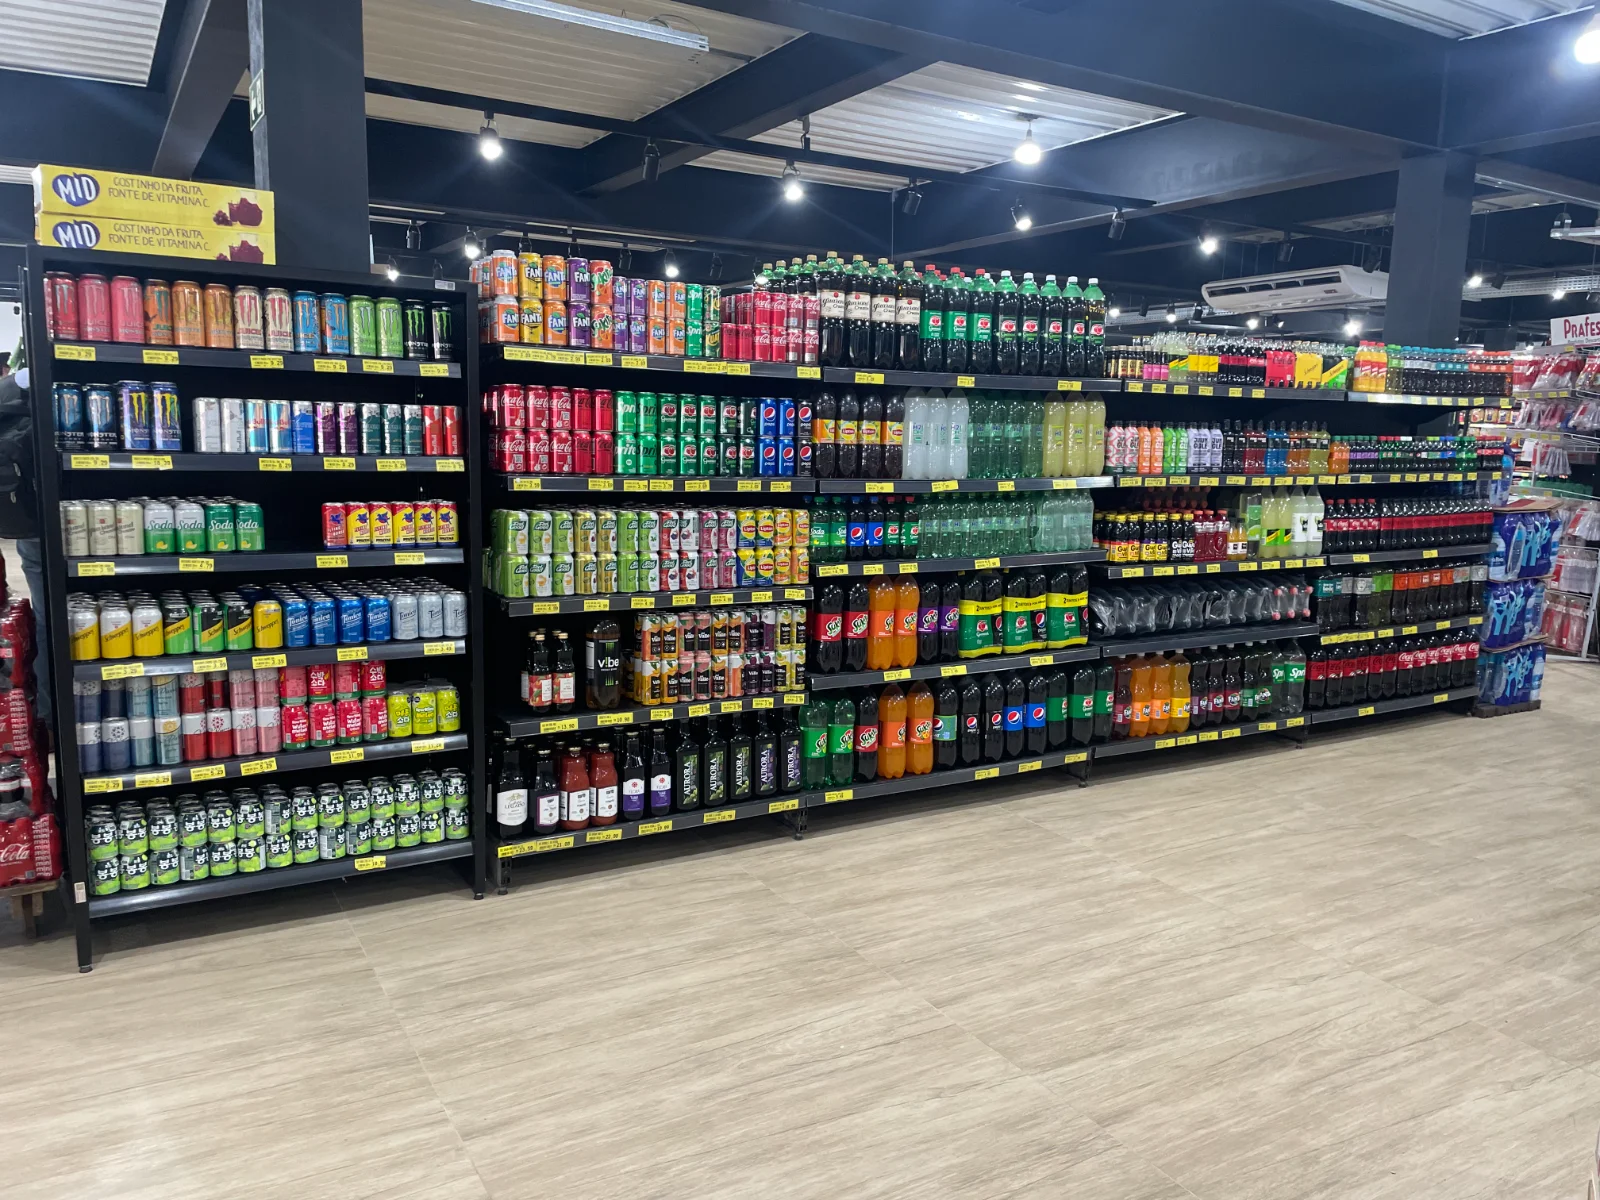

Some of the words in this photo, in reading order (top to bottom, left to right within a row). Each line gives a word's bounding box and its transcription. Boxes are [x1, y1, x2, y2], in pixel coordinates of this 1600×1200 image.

[58, 172, 96, 203] MID
[108, 187, 140, 200] FONTE
[142, 191, 154, 201] DE
[156, 192, 202, 207] VITAMINA
[162, 182, 174, 193] DA
[175, 184, 203, 196] FRUTA
[108, 233, 140, 245] FONTE
[142, 236, 155, 246] DE
[156, 239, 202, 250] VITAMINA
[162, 227, 174, 237] DA
[176, 229, 204, 240] FRUTA
[208, 519, 233, 531] Soda
[709, 757, 718, 792] AURORA
[735, 753, 743, 787] AURORA
[760, 749, 769, 783] AURORA
[787, 746, 795, 779] AURORA
[683, 762, 691, 796] AURORA
[1, 843, 33, 863] Cola
